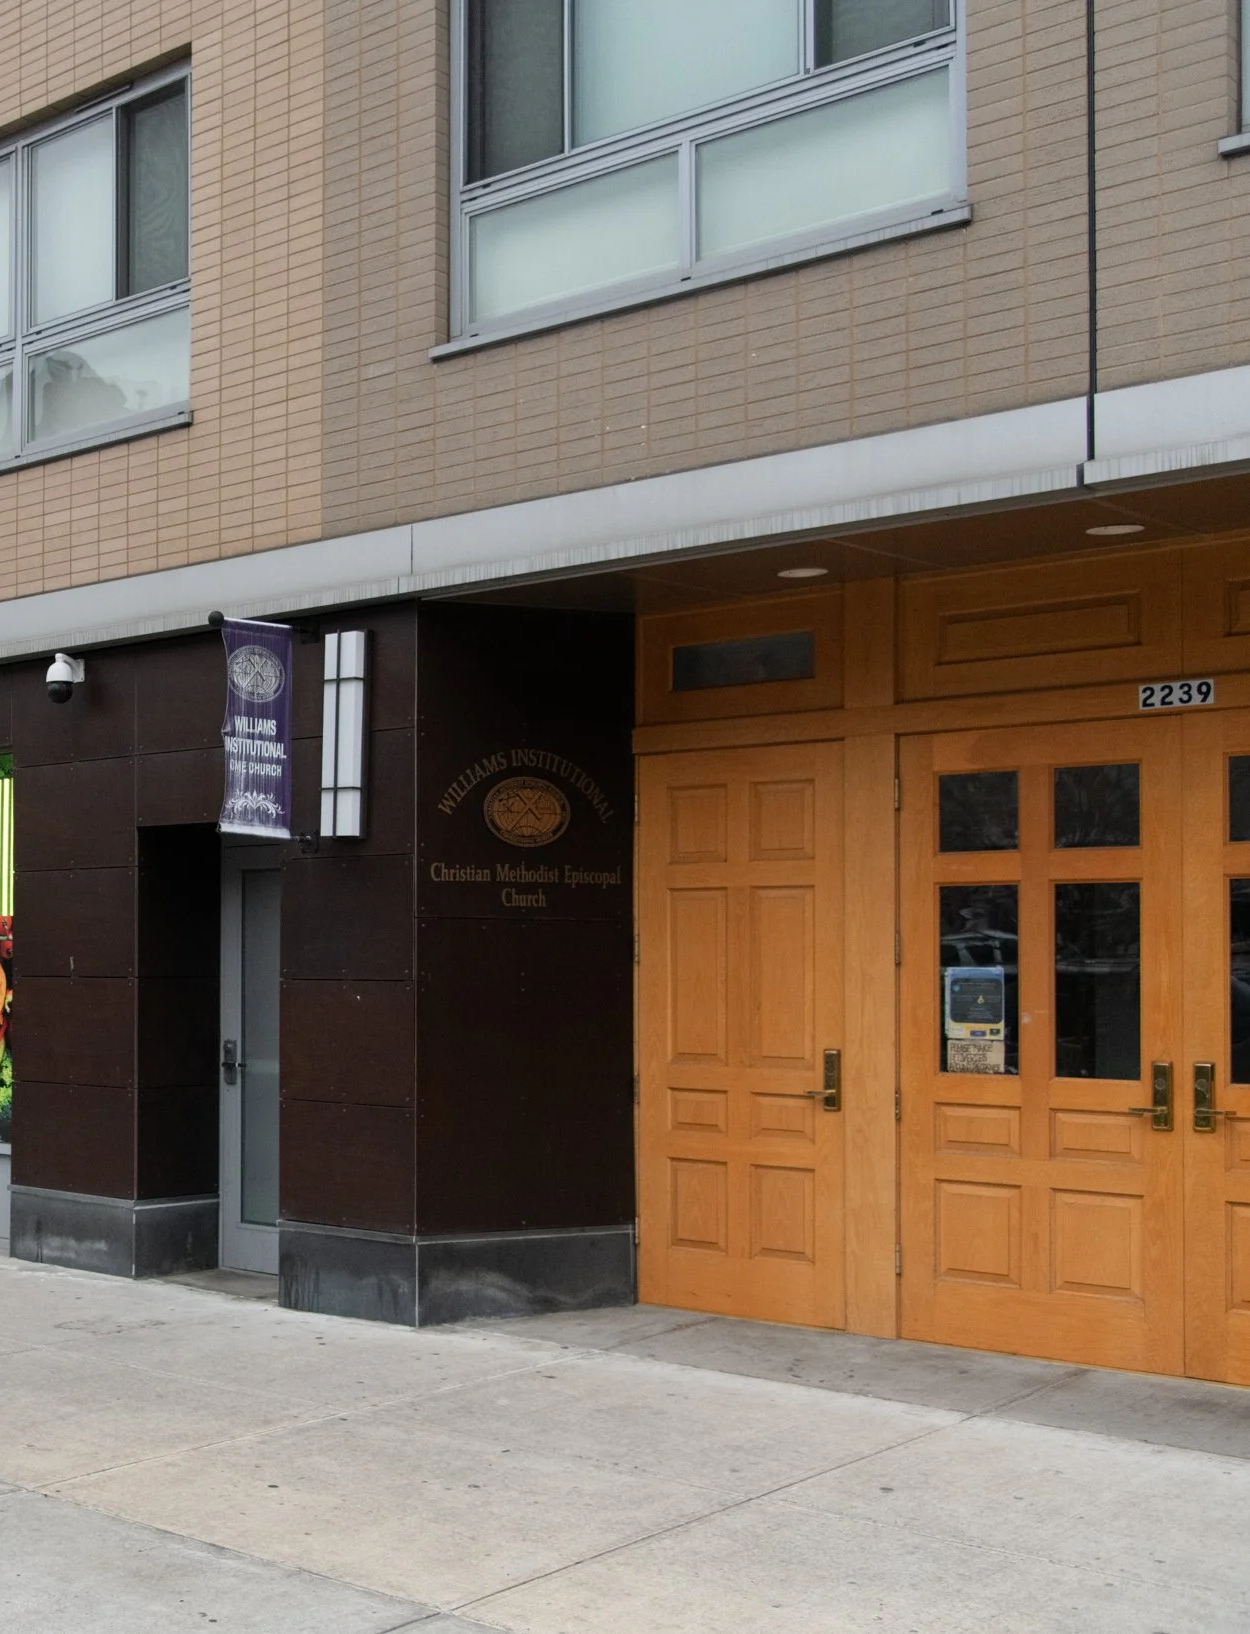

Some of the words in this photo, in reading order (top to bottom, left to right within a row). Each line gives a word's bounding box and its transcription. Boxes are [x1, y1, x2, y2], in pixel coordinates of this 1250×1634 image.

[1141, 681, 1212, 708] 2239
[234, 715, 277, 737] WILLIAMS
[225, 735, 287, 759] INSTITUTIONAL
[249, 762, 282, 777] CHURCH
[437, 751, 508, 817] WILLIAMS
[511, 748, 614, 825] INSTITUTIONAL
[430, 862, 491, 882] Christian
[495, 861, 559, 884] Methodist
[564, 864, 622, 889] Episcopal
[501, 887, 547, 907] Church
